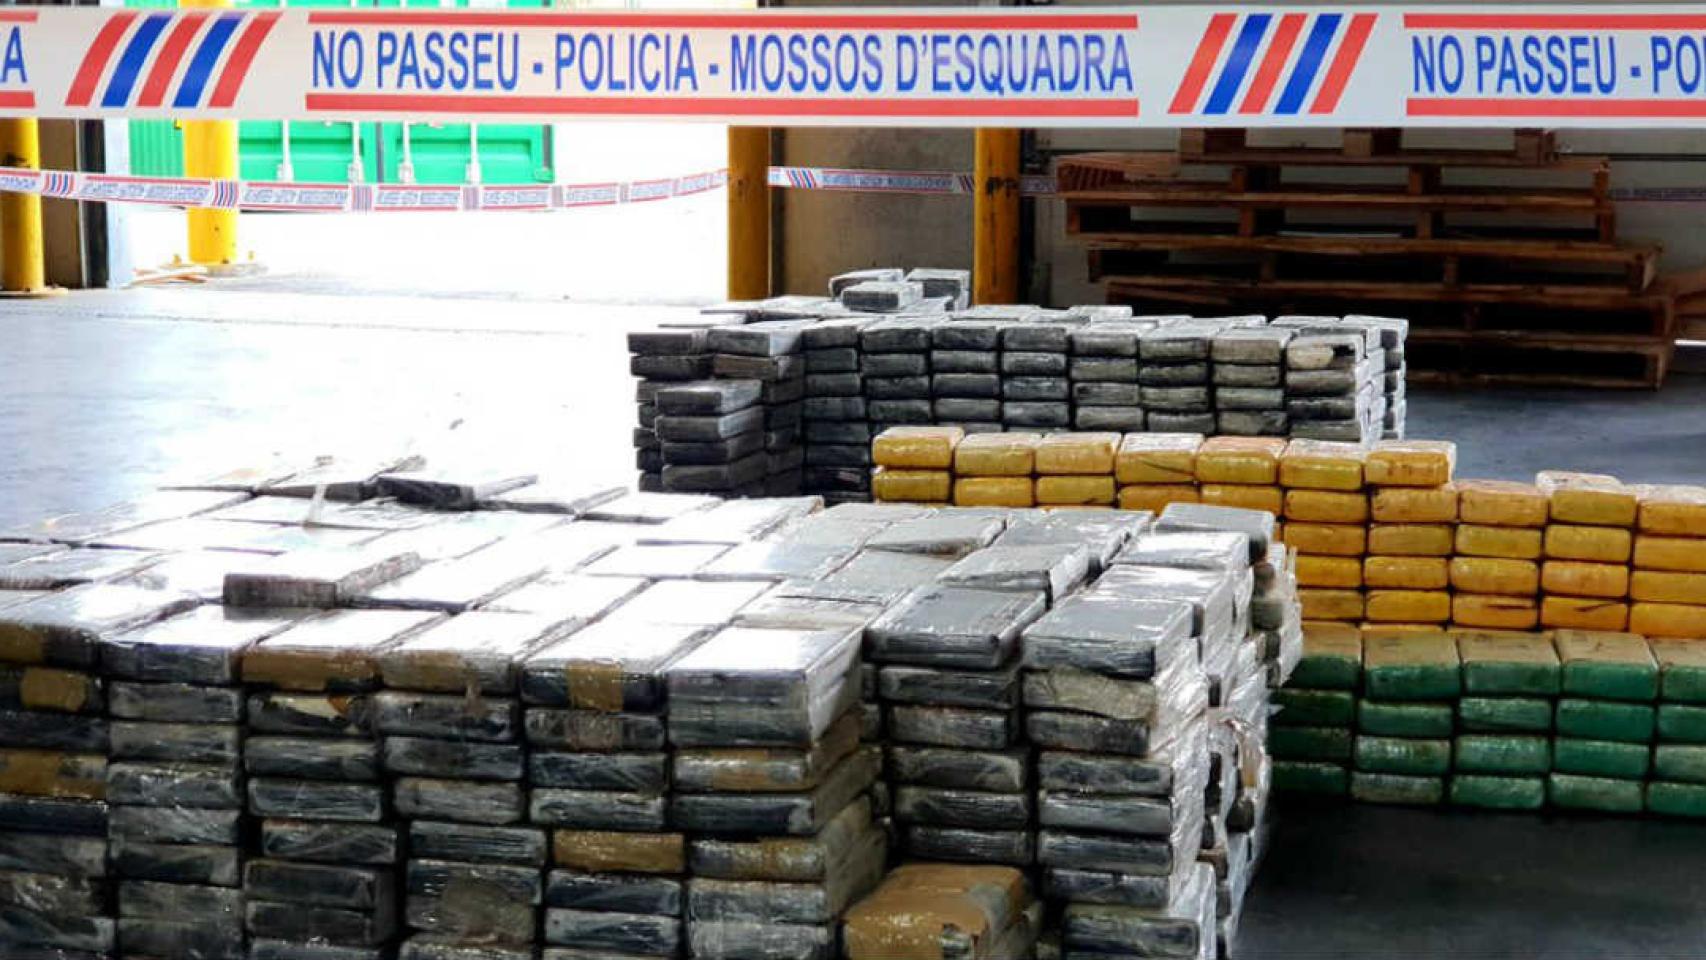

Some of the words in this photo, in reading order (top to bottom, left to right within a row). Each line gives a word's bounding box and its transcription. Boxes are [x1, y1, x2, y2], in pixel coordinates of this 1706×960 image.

[0, 26, 28, 84] A
[312, 32, 365, 90] NO
[377, 32, 519, 92] PASSEU
[555, 33, 698, 93] POLICIA
[731, 34, 884, 94] MOSSOS
[896, 33, 1134, 96] D'ESQUADRA
[1411, 34, 1465, 95] NO
[1475, 34, 1617, 95] PASSEU
[1650, 34, 1706, 94] PO
